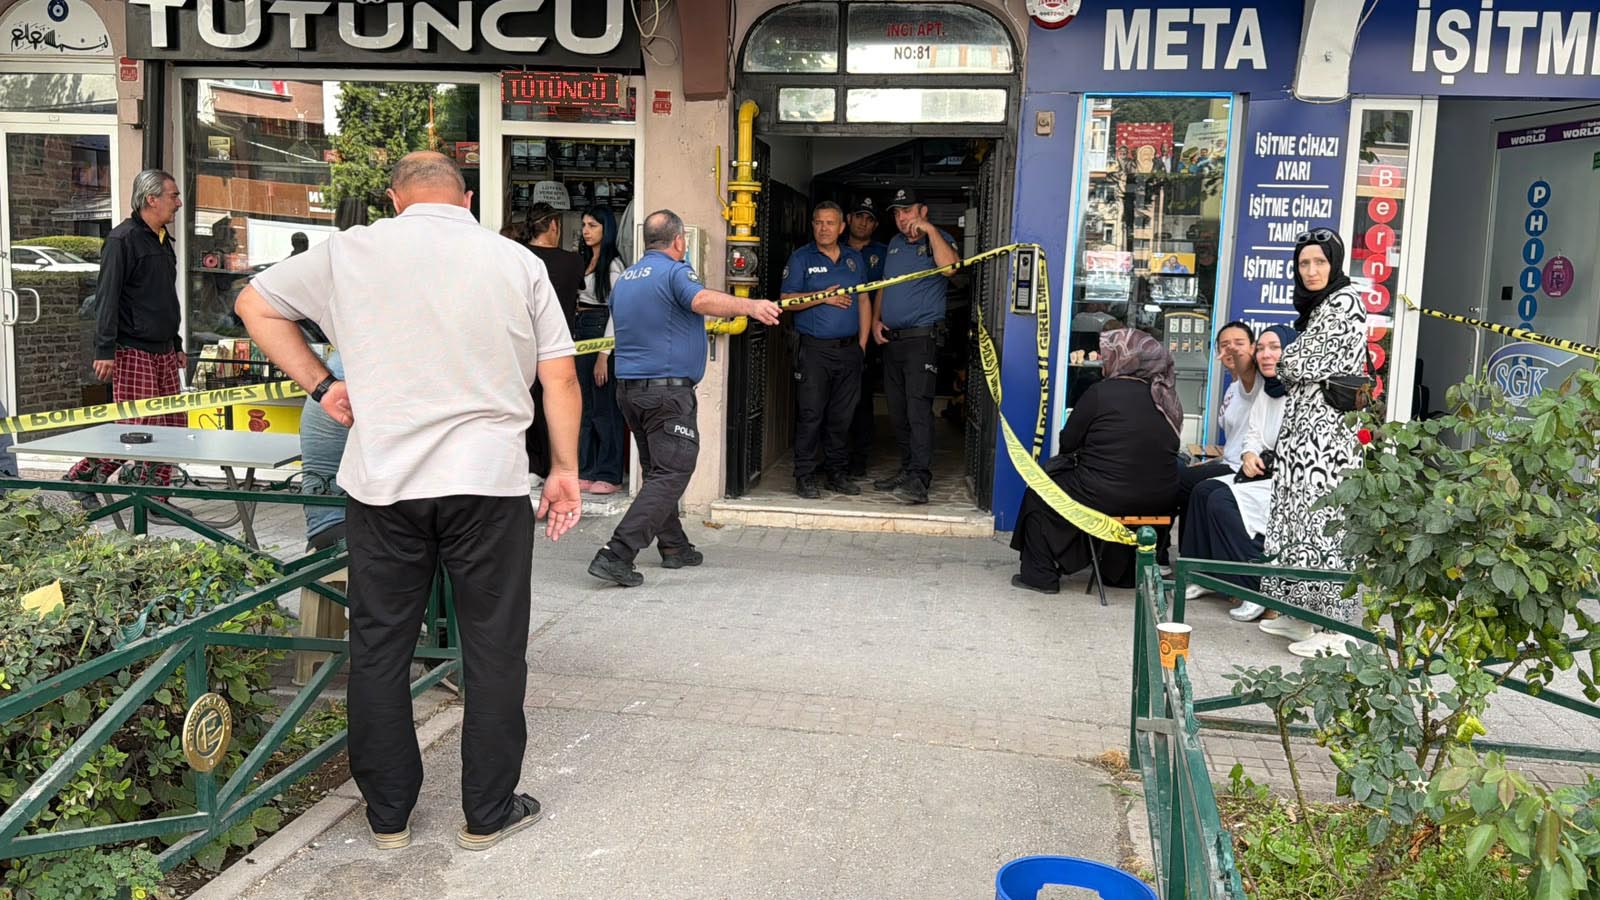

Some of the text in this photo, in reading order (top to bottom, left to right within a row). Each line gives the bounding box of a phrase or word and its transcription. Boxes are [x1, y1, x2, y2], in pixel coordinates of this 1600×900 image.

[1103, 8, 1268, 70] META
[894, 46, 931, 60] NO:81
[508, 75, 606, 100] TÜTÜNCÜ
[1255, 132, 1340, 158] İŞİTME CİHAZI
[1510, 134, 1546, 145] WORLD
[1275, 161, 1311, 181] AYARI
[1249, 193, 1333, 219] İŞİTME CİHAZI
[1243, 255, 1285, 281] İŞİTME
[1496, 363, 1549, 397] SGK
